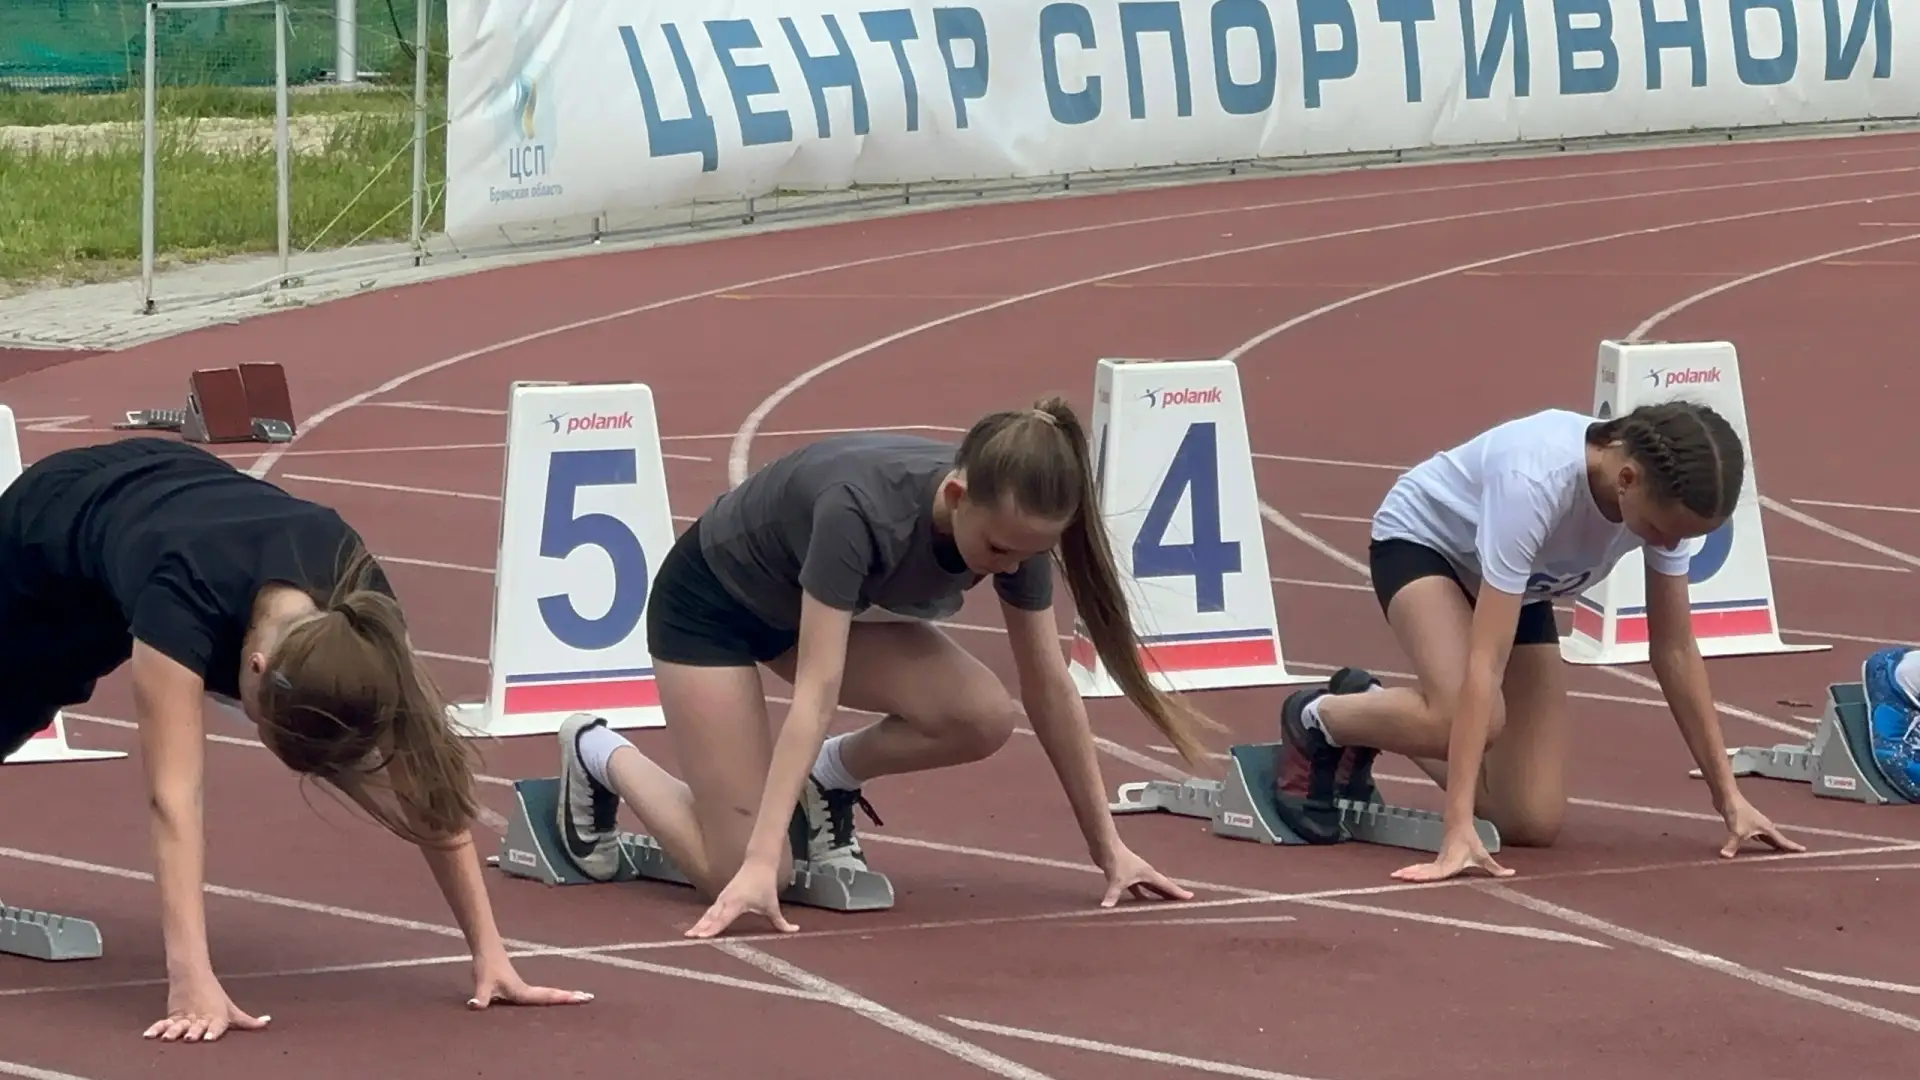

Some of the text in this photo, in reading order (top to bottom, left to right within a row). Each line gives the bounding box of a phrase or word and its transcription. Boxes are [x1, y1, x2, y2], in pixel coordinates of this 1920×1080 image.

[619, 7, 989, 172] ЦЕНТР
[509, 145, 546, 185] ЦСП
[1162, 386, 1222, 409] polanik
[1665, 367, 1722, 388] polanik
[567, 411, 633, 434] polanik
[1132, 422, 1242, 613] 4
[537, 448, 649, 650] 5
